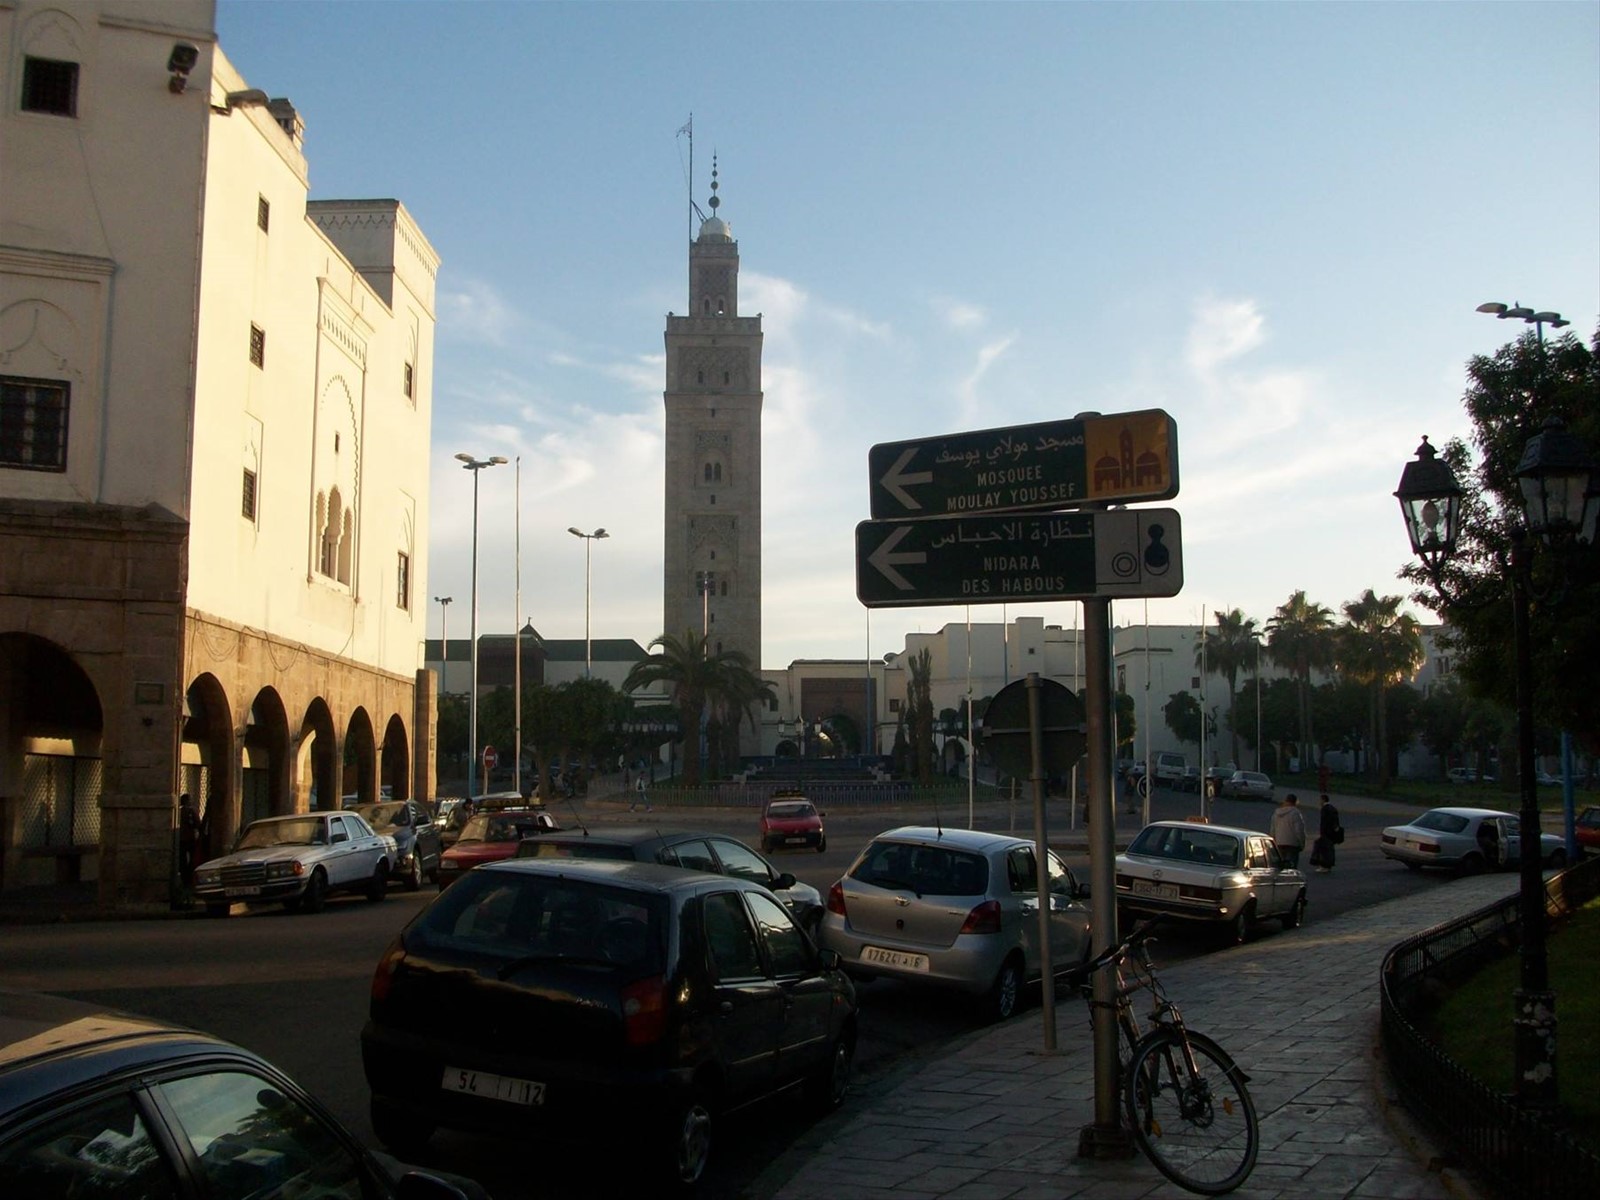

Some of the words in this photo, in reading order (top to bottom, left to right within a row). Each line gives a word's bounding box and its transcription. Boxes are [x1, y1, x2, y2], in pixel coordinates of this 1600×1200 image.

[935, 443, 981, 468] يوسف
[985, 434, 1029, 465] مولاي
[1034, 434, 1084, 452] مسجد
[977, 465, 1043, 487] MOSQUEE
[947, 491, 1001, 511] MOULAY
[1010, 483, 1076, 504] YOUSSEF
[1030, 520, 1093, 548] نظارة
[984, 555, 1041, 571] NIDARA
[962, 579, 990, 593] DES
[1002, 576, 1065, 593] HABOUS
[458, 1071, 477, 1093] 54
[523, 1083, 543, 1105] 12
